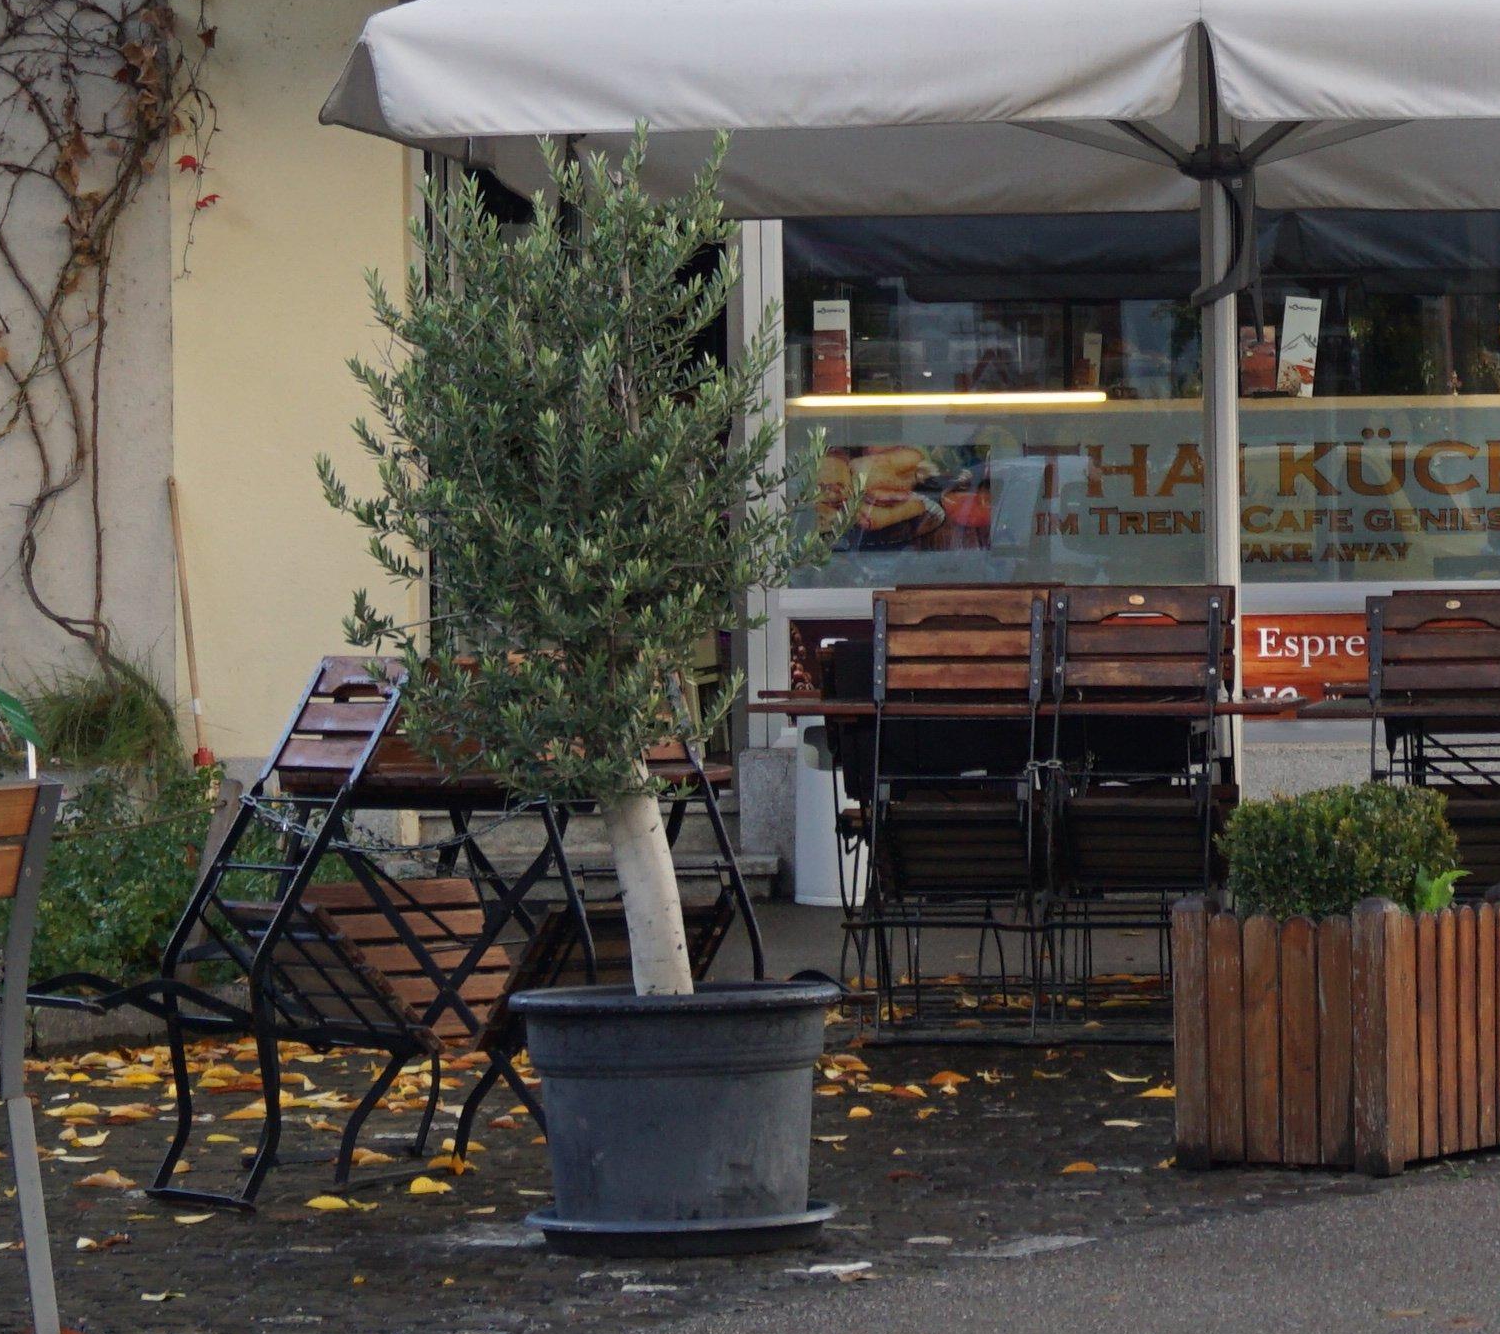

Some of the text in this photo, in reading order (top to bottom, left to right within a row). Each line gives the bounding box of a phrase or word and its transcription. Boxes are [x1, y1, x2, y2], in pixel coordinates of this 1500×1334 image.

[1035, 511, 1079, 536] IM
[1089, 507, 1206, 536] TREN
[1320, 542, 1414, 563] AWAY
[1257, 627, 1366, 668] Espre
